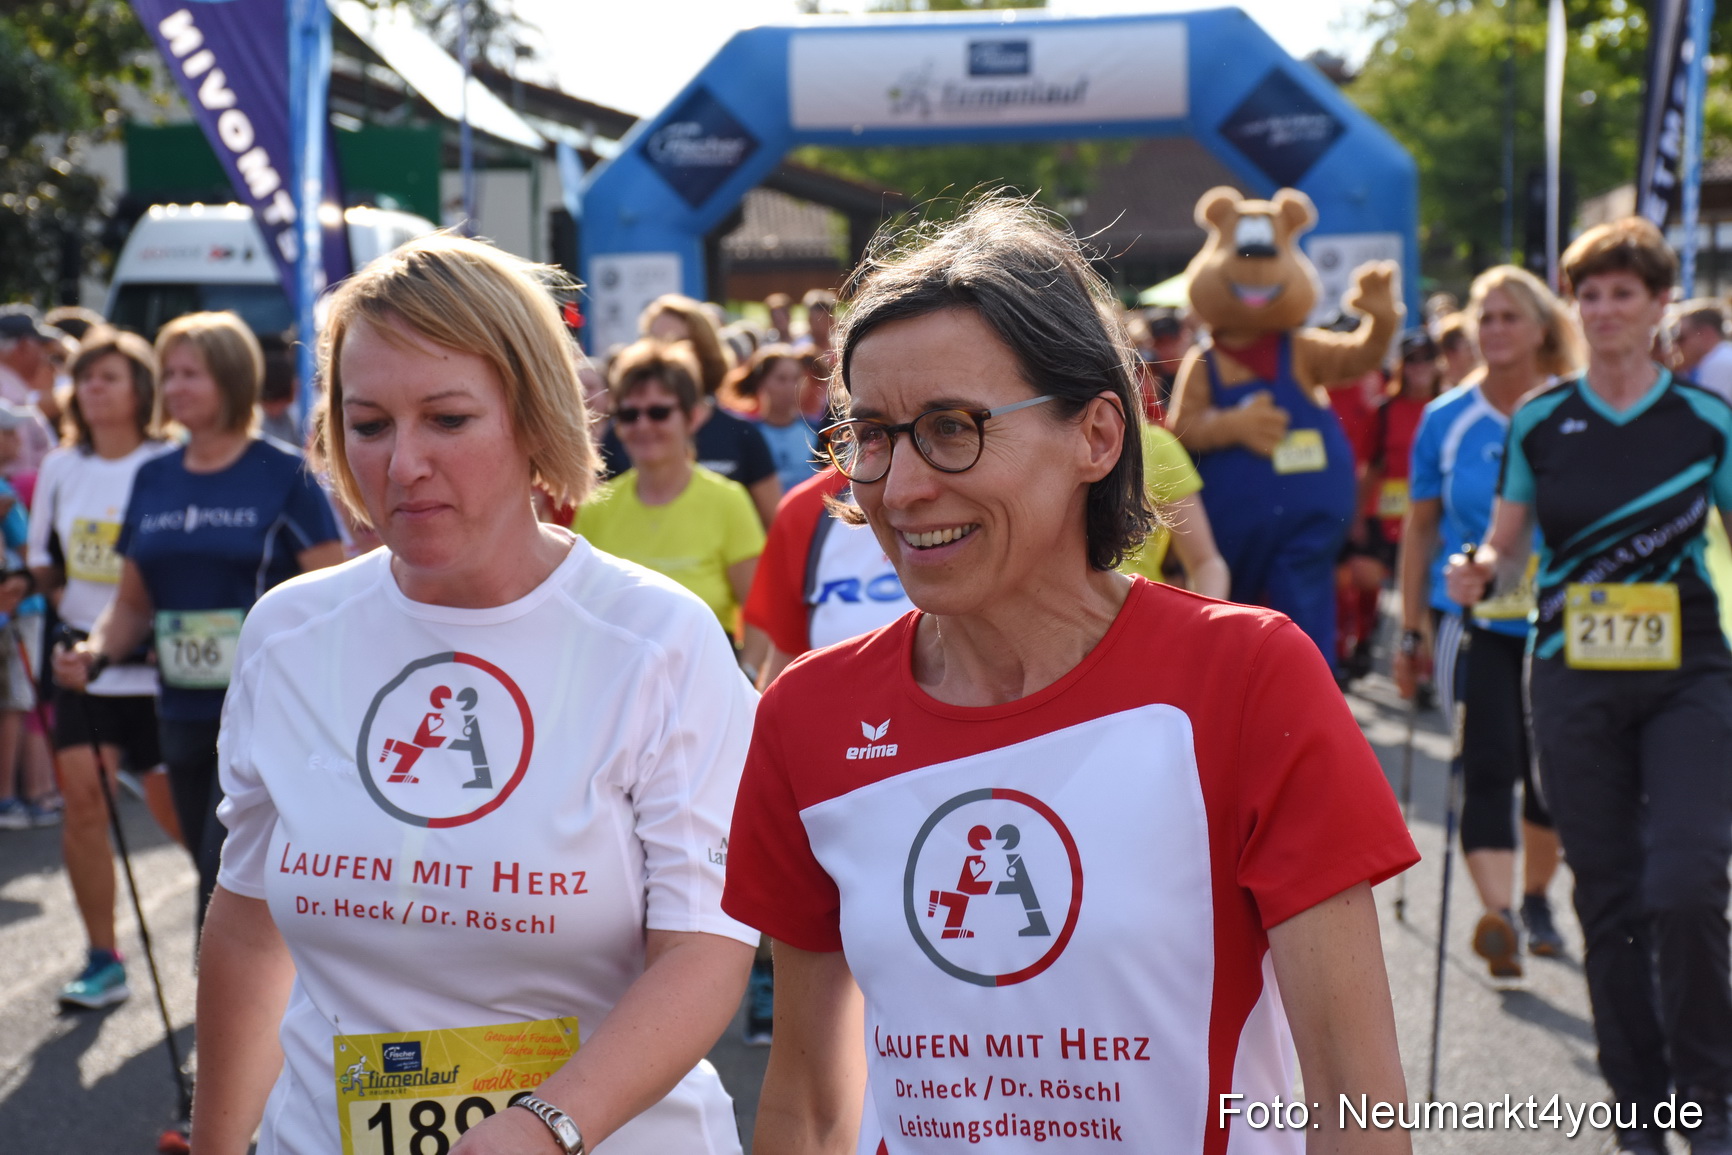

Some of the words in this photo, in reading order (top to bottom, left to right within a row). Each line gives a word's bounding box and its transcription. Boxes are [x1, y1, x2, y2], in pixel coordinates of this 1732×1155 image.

[1579, 615, 1664, 645] 2179
[172, 638, 221, 666] 706
[846, 743, 898, 760] erima
[296, 896, 327, 917] Dr.
[334, 899, 394, 921] Heck
[421, 904, 458, 926] Dr.
[466, 909, 555, 934] Röschl
[369, 1065, 460, 1088] firmenlauf
[473, 1069, 516, 1091] walk
[895, 1078, 919, 1098] Dr.
[921, 1077, 977, 1099] Heck
[1000, 1078, 1033, 1098] Dr.
[1039, 1080, 1121, 1102] Röschl
[898, 1113, 1123, 1144] Leistungsdiagnostik
